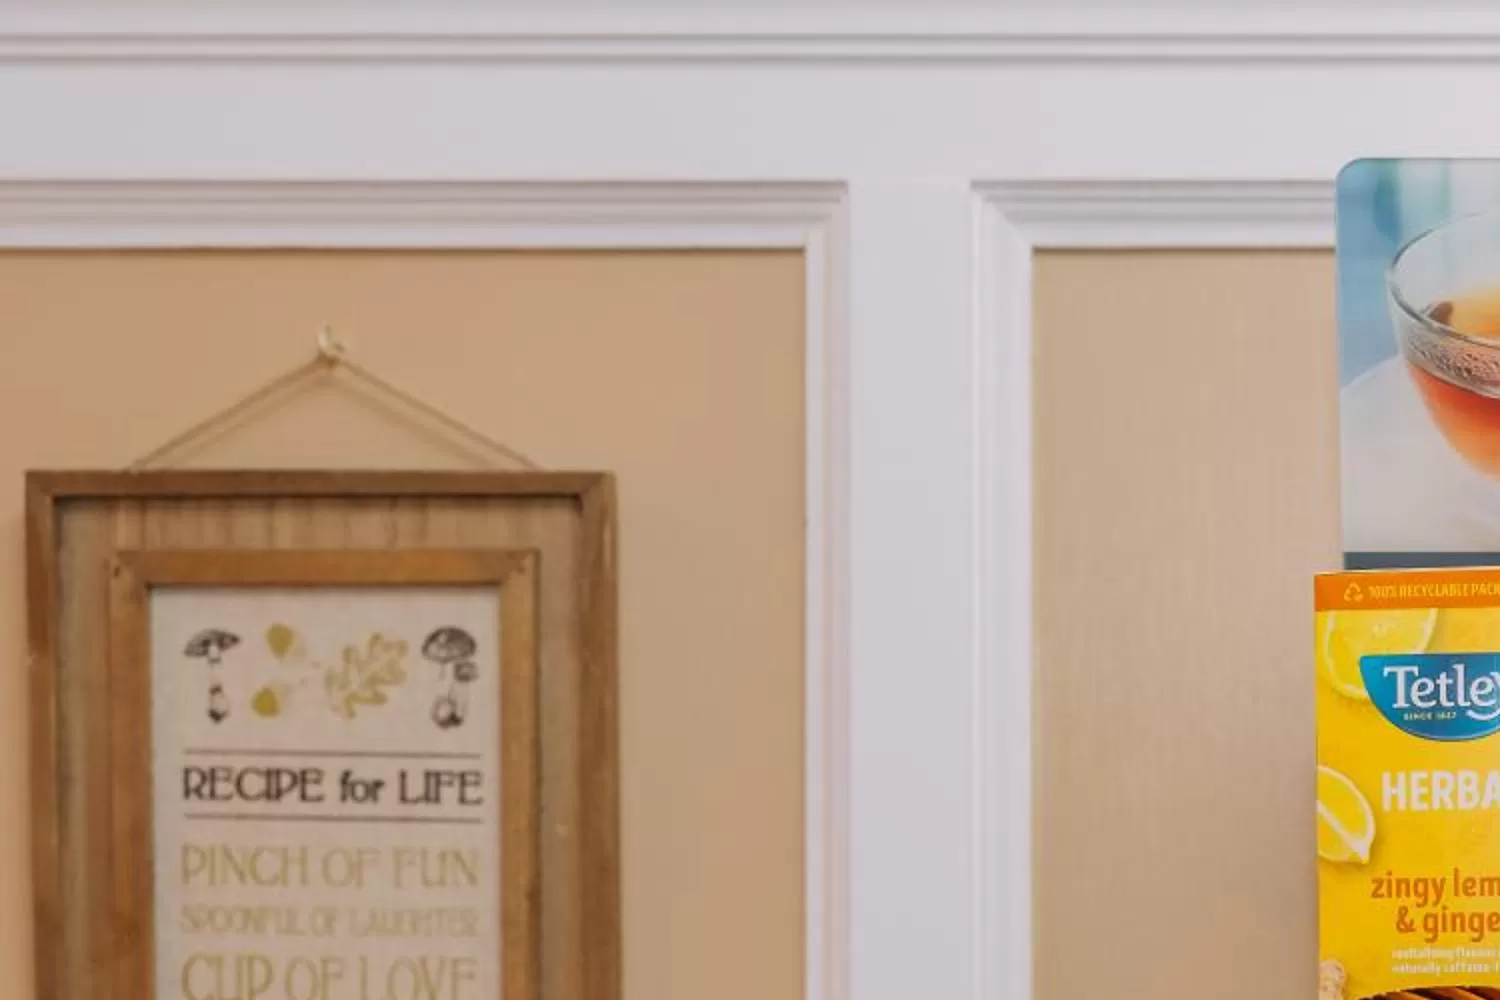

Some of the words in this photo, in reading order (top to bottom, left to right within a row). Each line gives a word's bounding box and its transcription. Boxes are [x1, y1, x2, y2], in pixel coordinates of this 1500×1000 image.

[1399, 582, 1469, 599] RECYCLABLE
[182, 766, 325, 802] RECIPE
[339, 770, 385, 804] for
[398, 769, 484, 806] LIFE
[181, 842, 310, 888] PINCH
[321, 845, 382, 890] OF
[392, 846, 480, 890] FUN
[1371, 870, 1447, 909] zingy
[1395, 905, 1417, 934] &
